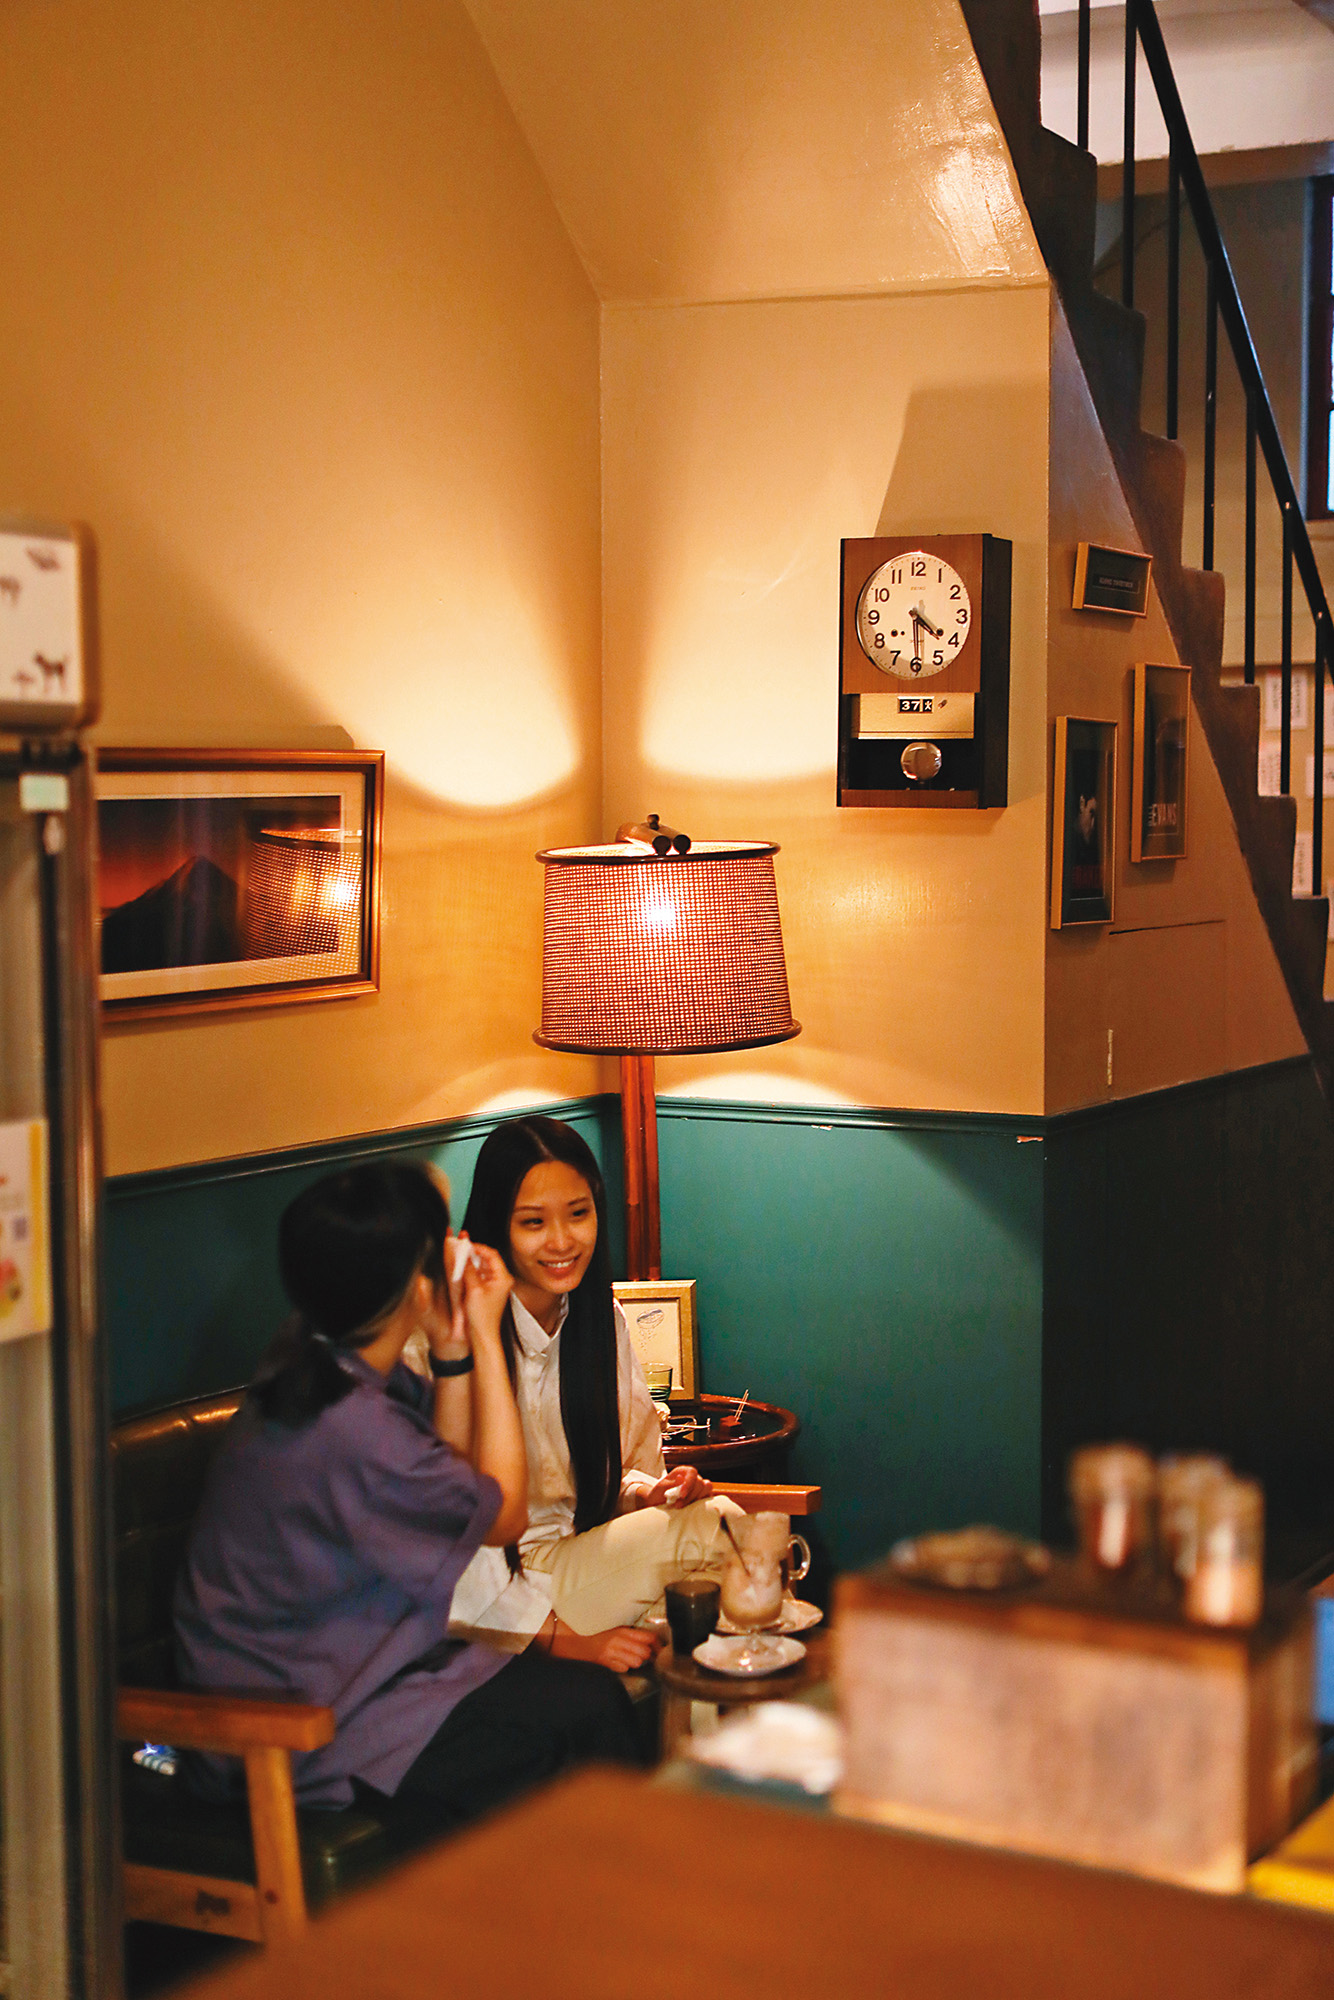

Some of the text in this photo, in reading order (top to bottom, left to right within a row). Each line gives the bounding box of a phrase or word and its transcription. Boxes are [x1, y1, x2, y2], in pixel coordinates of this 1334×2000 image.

[911, 561, 926, 576] 12
[938, 568, 942, 583] 1
[891, 569, 902, 584] 11
[875, 588, 890, 603] 10
[949, 585, 961, 600] 2
[868, 610, 880, 625] 9
[955, 608, 968, 624] 3
[874, 632, 885, 649] 8
[948, 632, 960, 648] 4
[890, 650, 901, 666] 7
[910, 656, 922, 673] 6
[932, 650, 944, 666] 5
